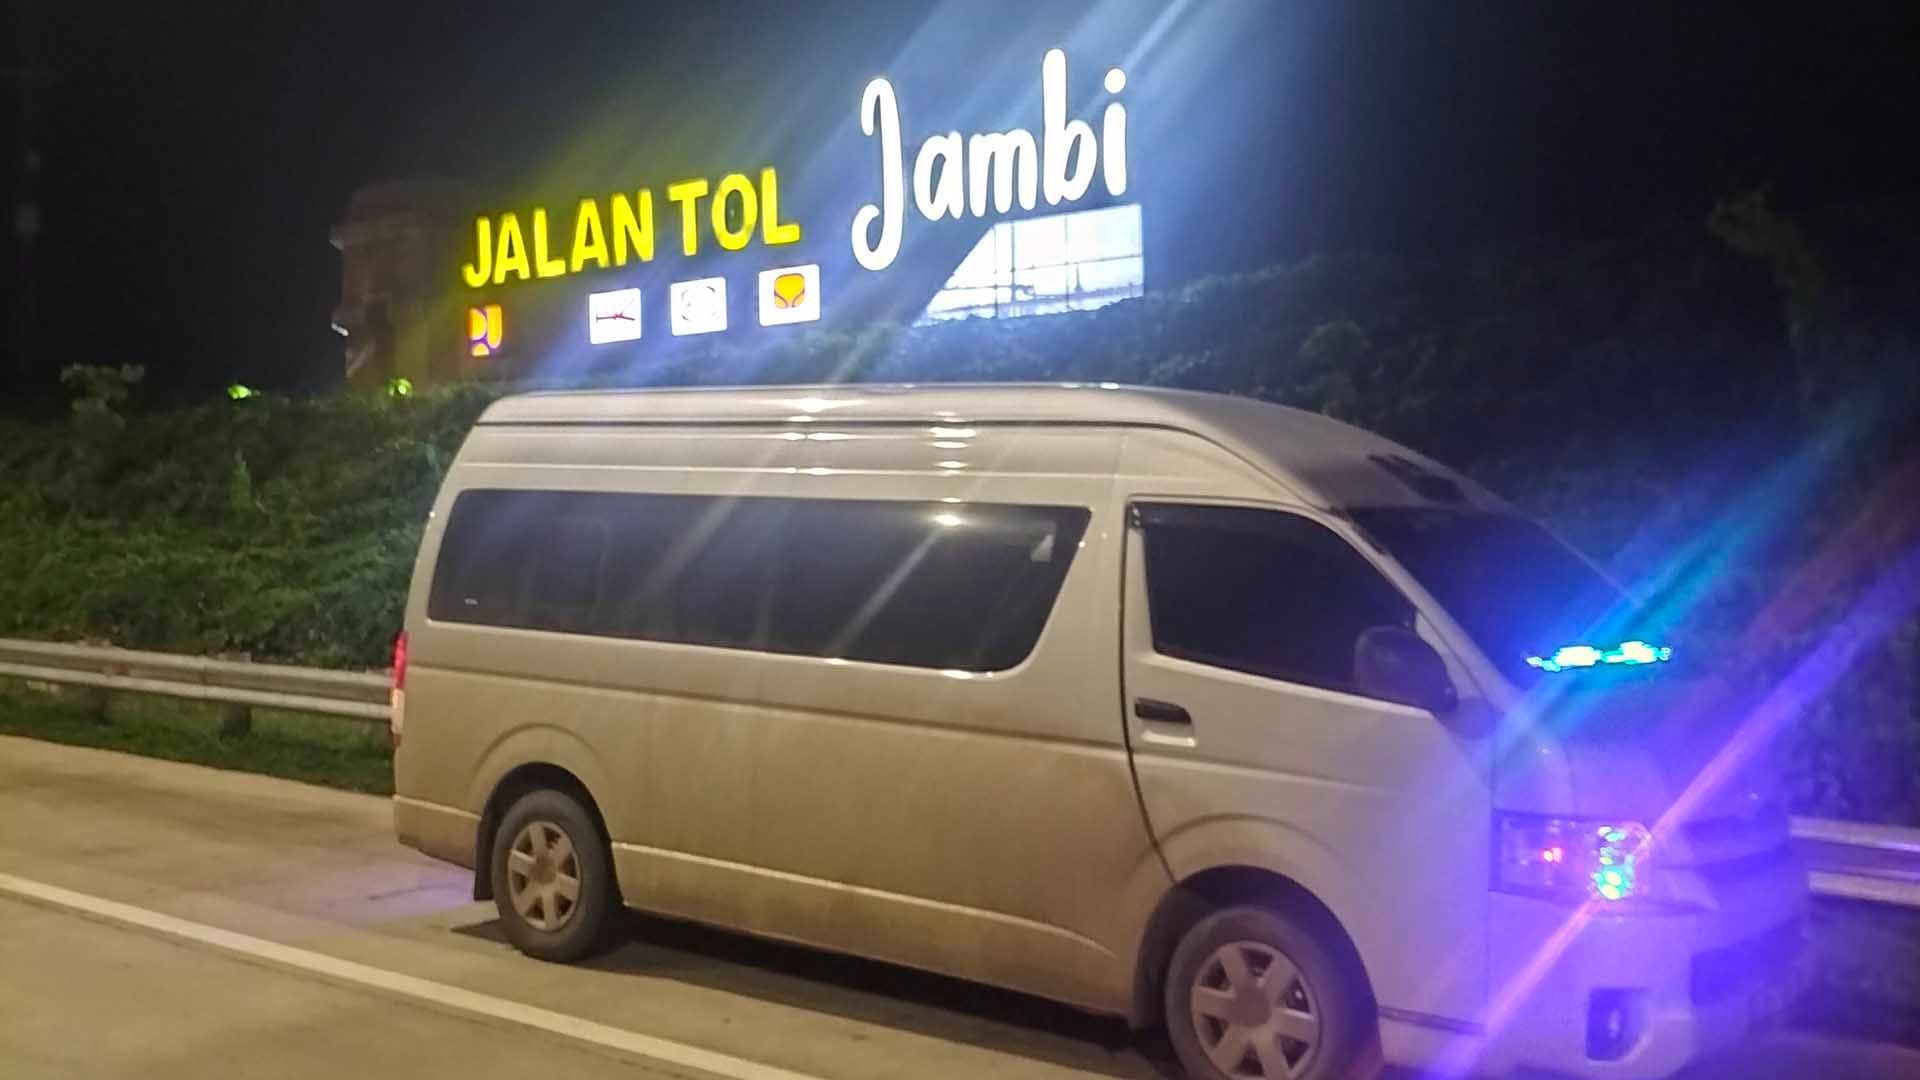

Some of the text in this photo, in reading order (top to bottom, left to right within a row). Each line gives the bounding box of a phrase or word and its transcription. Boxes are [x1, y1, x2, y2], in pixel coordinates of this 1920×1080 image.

[463, 48, 1127, 288] JALAN TOL Jambi
